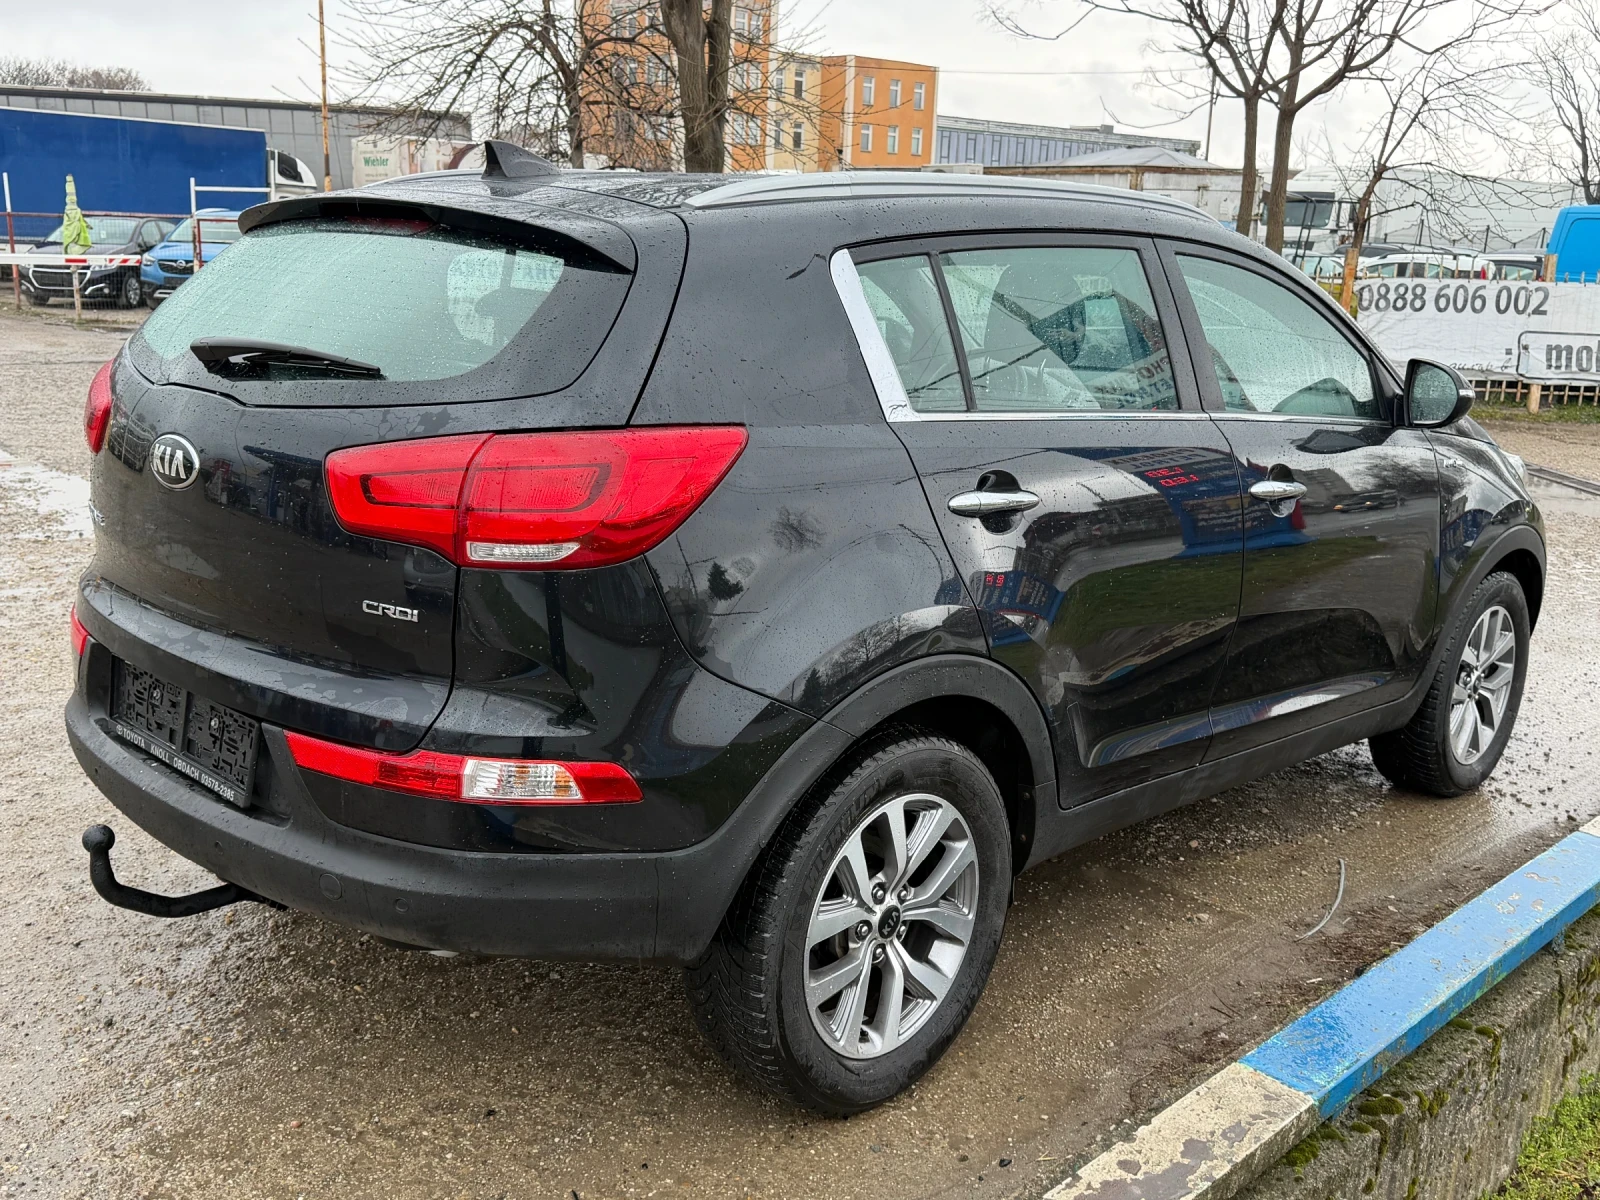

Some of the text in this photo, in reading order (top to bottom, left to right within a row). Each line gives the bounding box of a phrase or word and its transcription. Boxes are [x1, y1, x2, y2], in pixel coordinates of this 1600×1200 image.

[363, 156, 389, 167] Wiehler
[1357, 283, 1550, 316] 0888 606 002
[153, 443, 187, 479] KIA
[122, 728, 146, 749] TOYOTA
[150, 745, 171, 763] KNOLL
[173, 758, 200, 781] OBDACH
[881, 911, 899, 936] KIA
